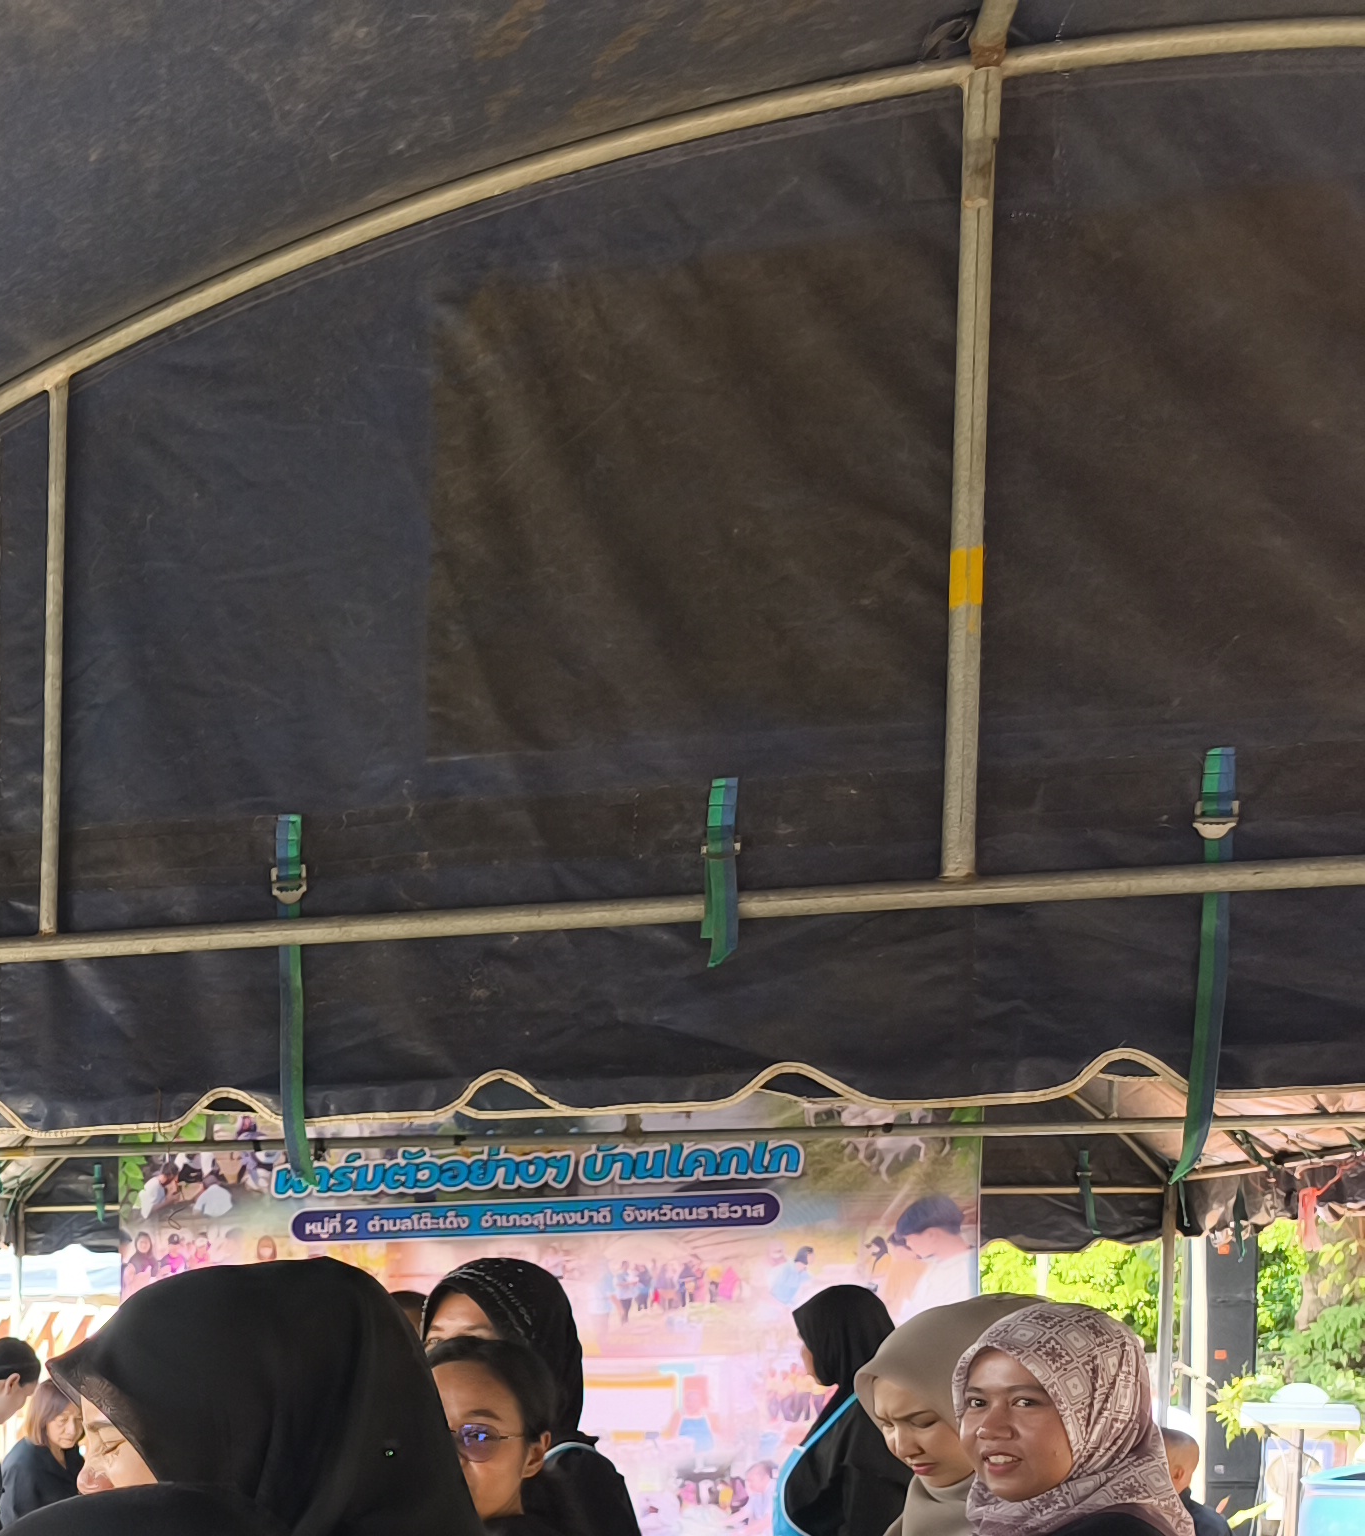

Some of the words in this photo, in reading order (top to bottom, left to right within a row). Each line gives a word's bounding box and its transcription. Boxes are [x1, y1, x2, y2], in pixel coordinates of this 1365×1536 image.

[345, 1218, 358, 1233] 2
[480, 1207, 612, 1230] อำเภอสุไหงปาดี
[622, 1202, 766, 1222] จังหวัดนราธิวาส
